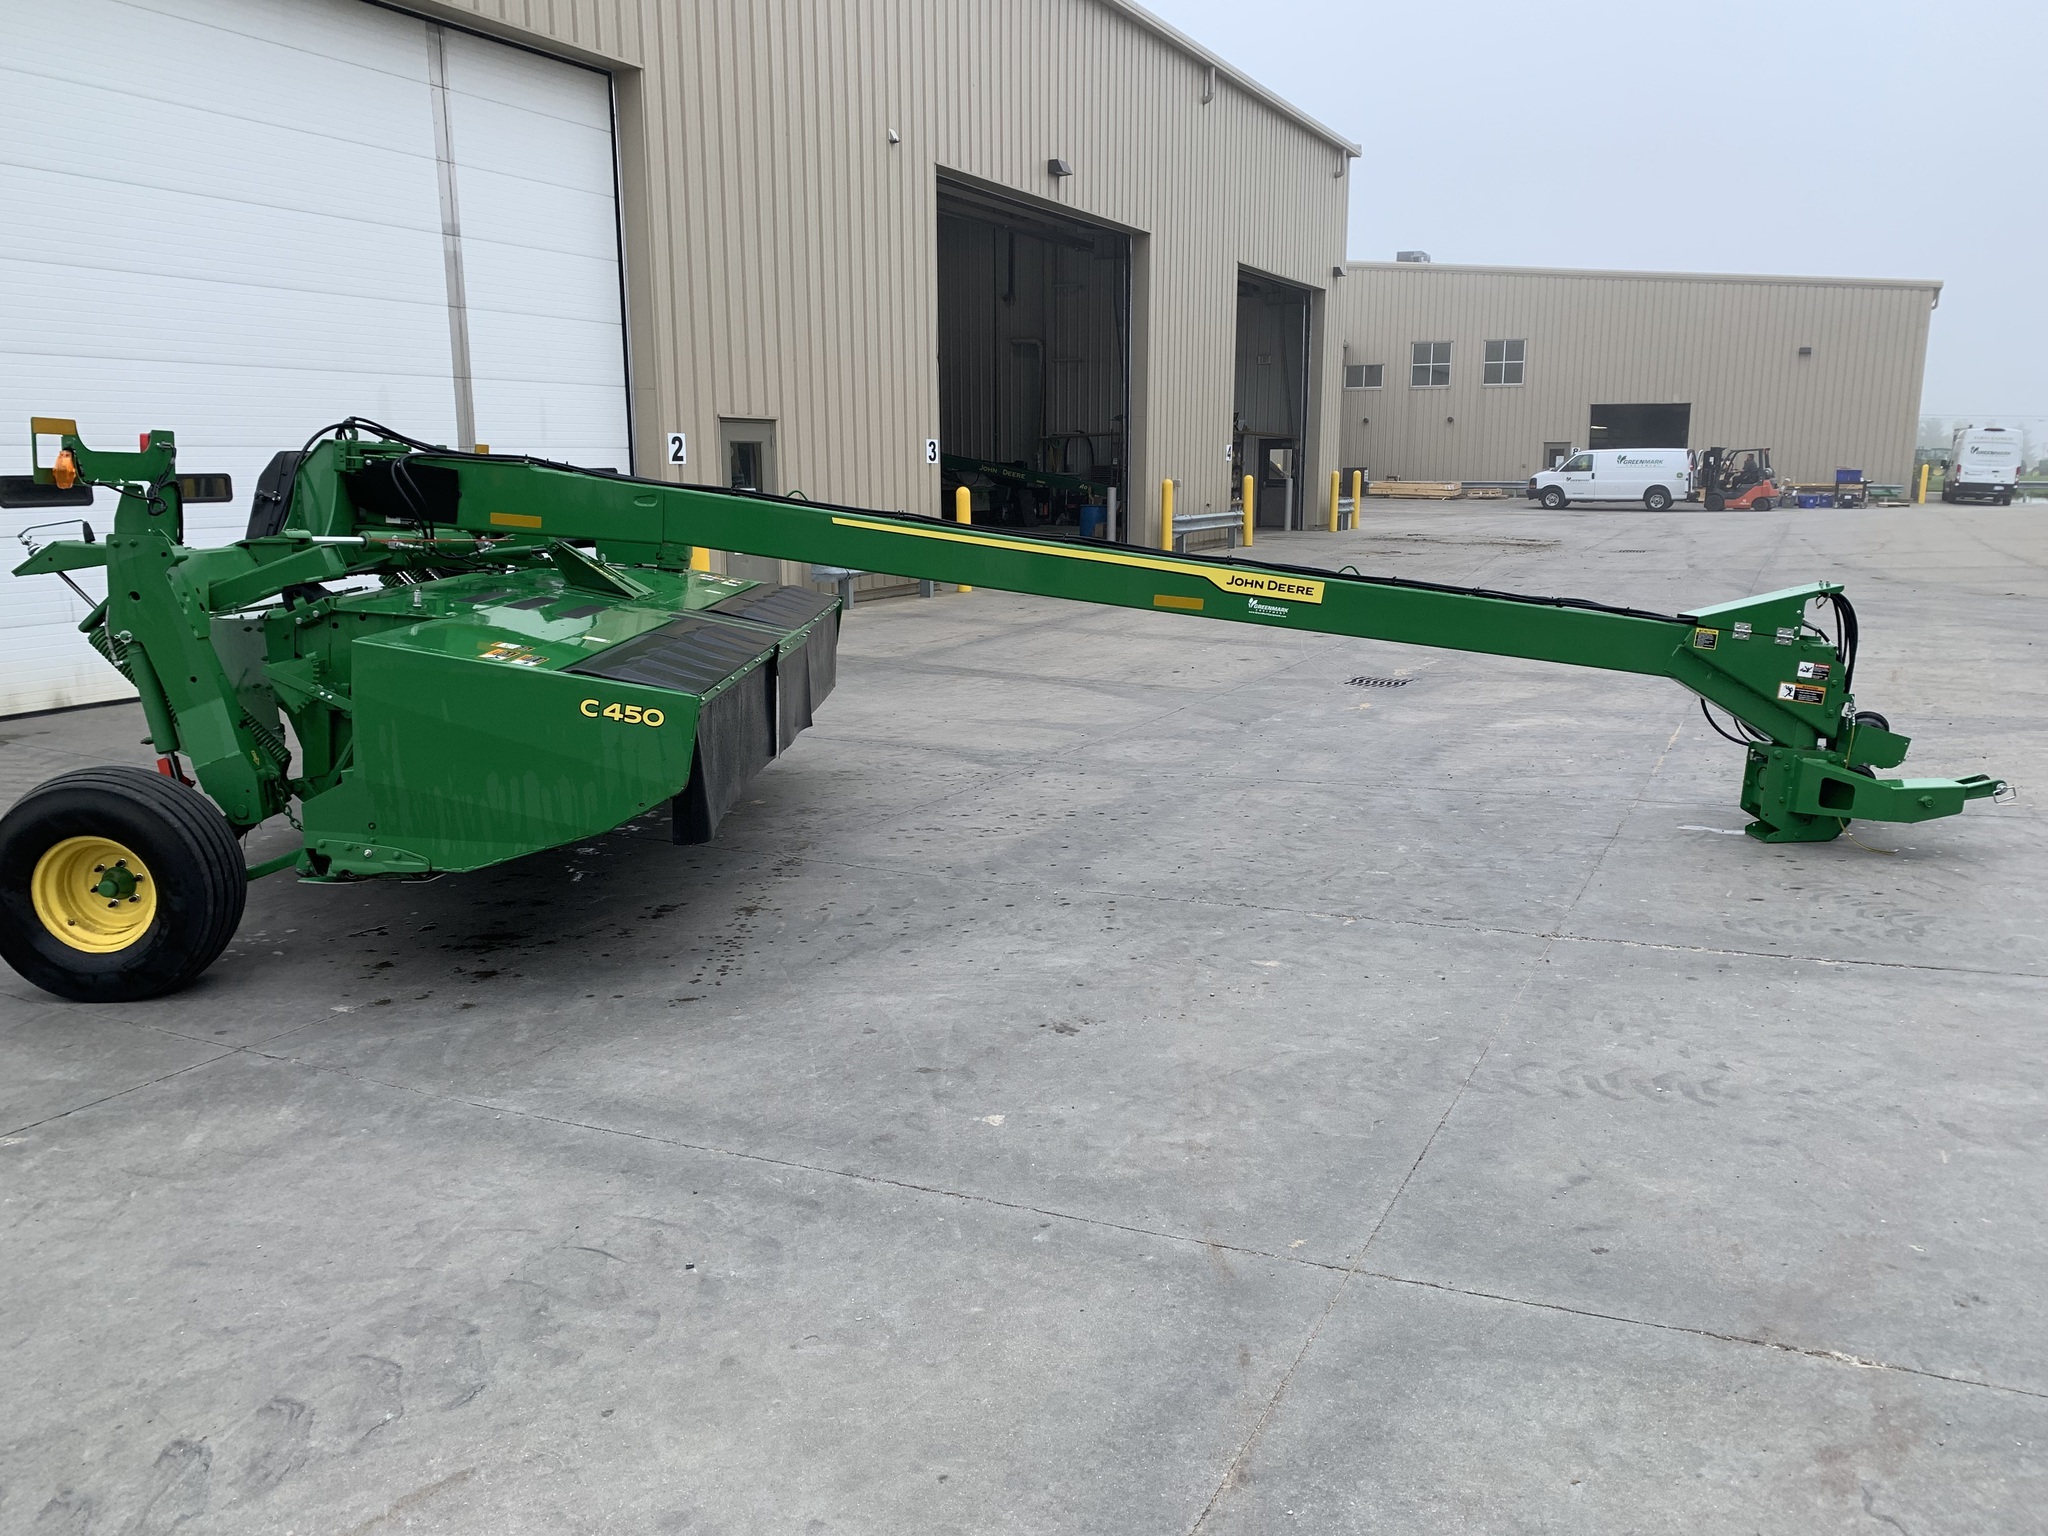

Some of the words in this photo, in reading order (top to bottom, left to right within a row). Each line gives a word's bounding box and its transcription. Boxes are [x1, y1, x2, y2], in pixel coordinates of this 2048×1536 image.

[671, 436, 684, 461] 2
[928, 441, 936, 461] 3
[1227, 445, 1232, 460] 4
[979, 464, 998, 474] JOHN
[1002, 468, 1026, 480] DEERE
[1226, 575, 1264, 590] JOHN
[1267, 580, 1315, 596] DEERE
[1253, 603, 1289, 613] GREENMARK
